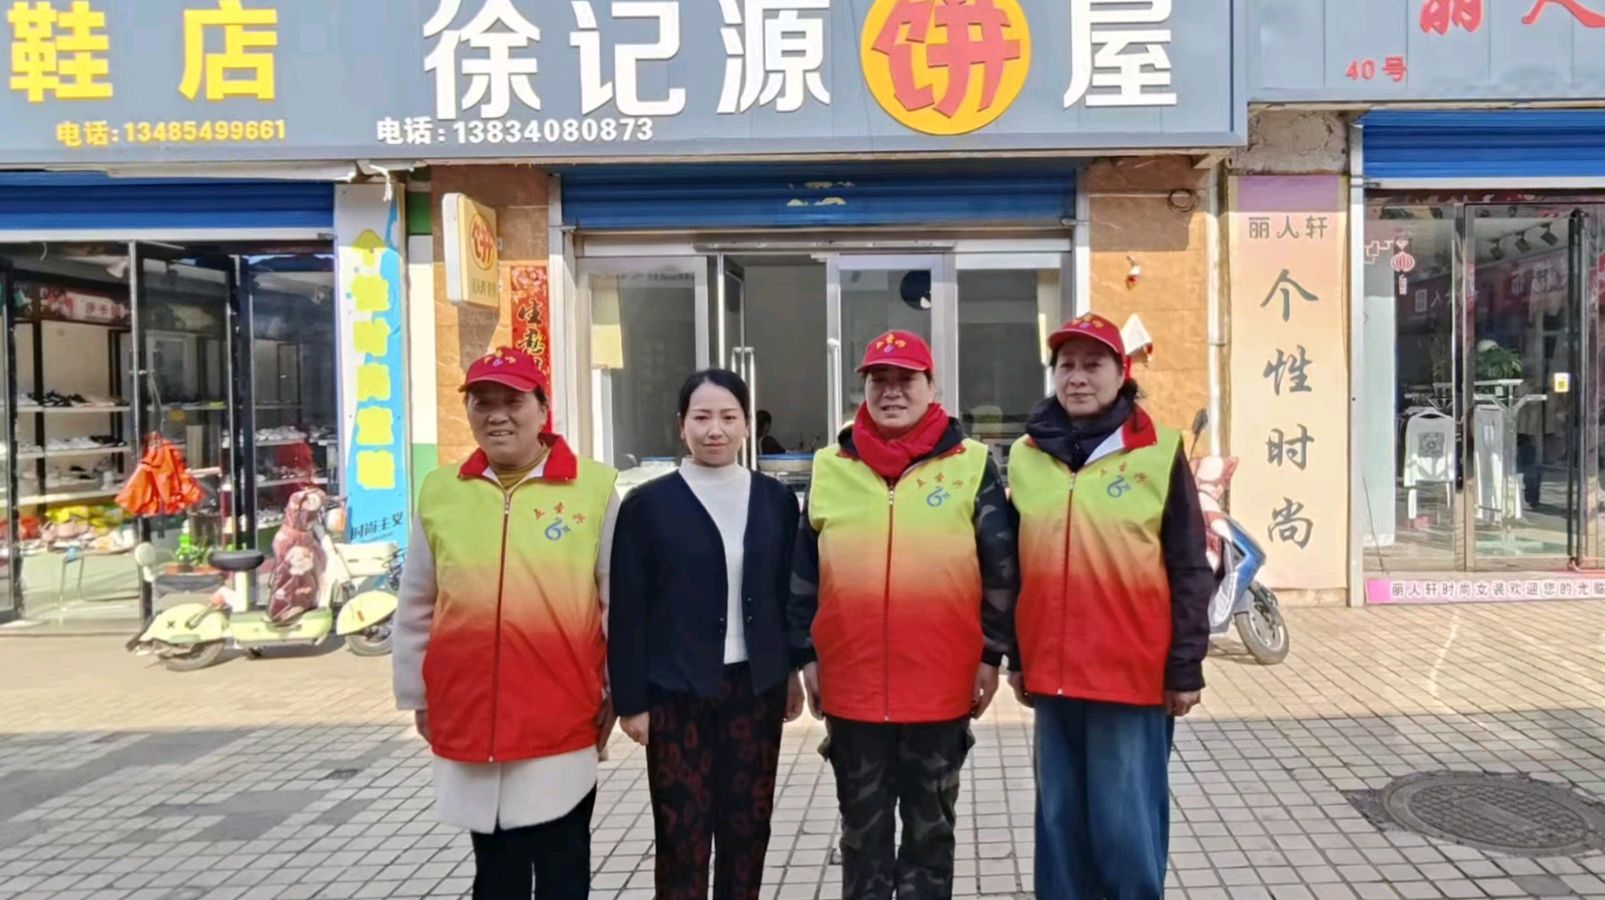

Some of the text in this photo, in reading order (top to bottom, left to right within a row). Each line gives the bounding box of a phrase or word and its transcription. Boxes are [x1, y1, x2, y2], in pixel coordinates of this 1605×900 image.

[7, 0, 278, 103] 鞋店
[1346, 56, 1407, 81] 40号
[1248, 216, 1328, 239] 丽人轩
[1261, 269, 1319, 549] 个性时尚
